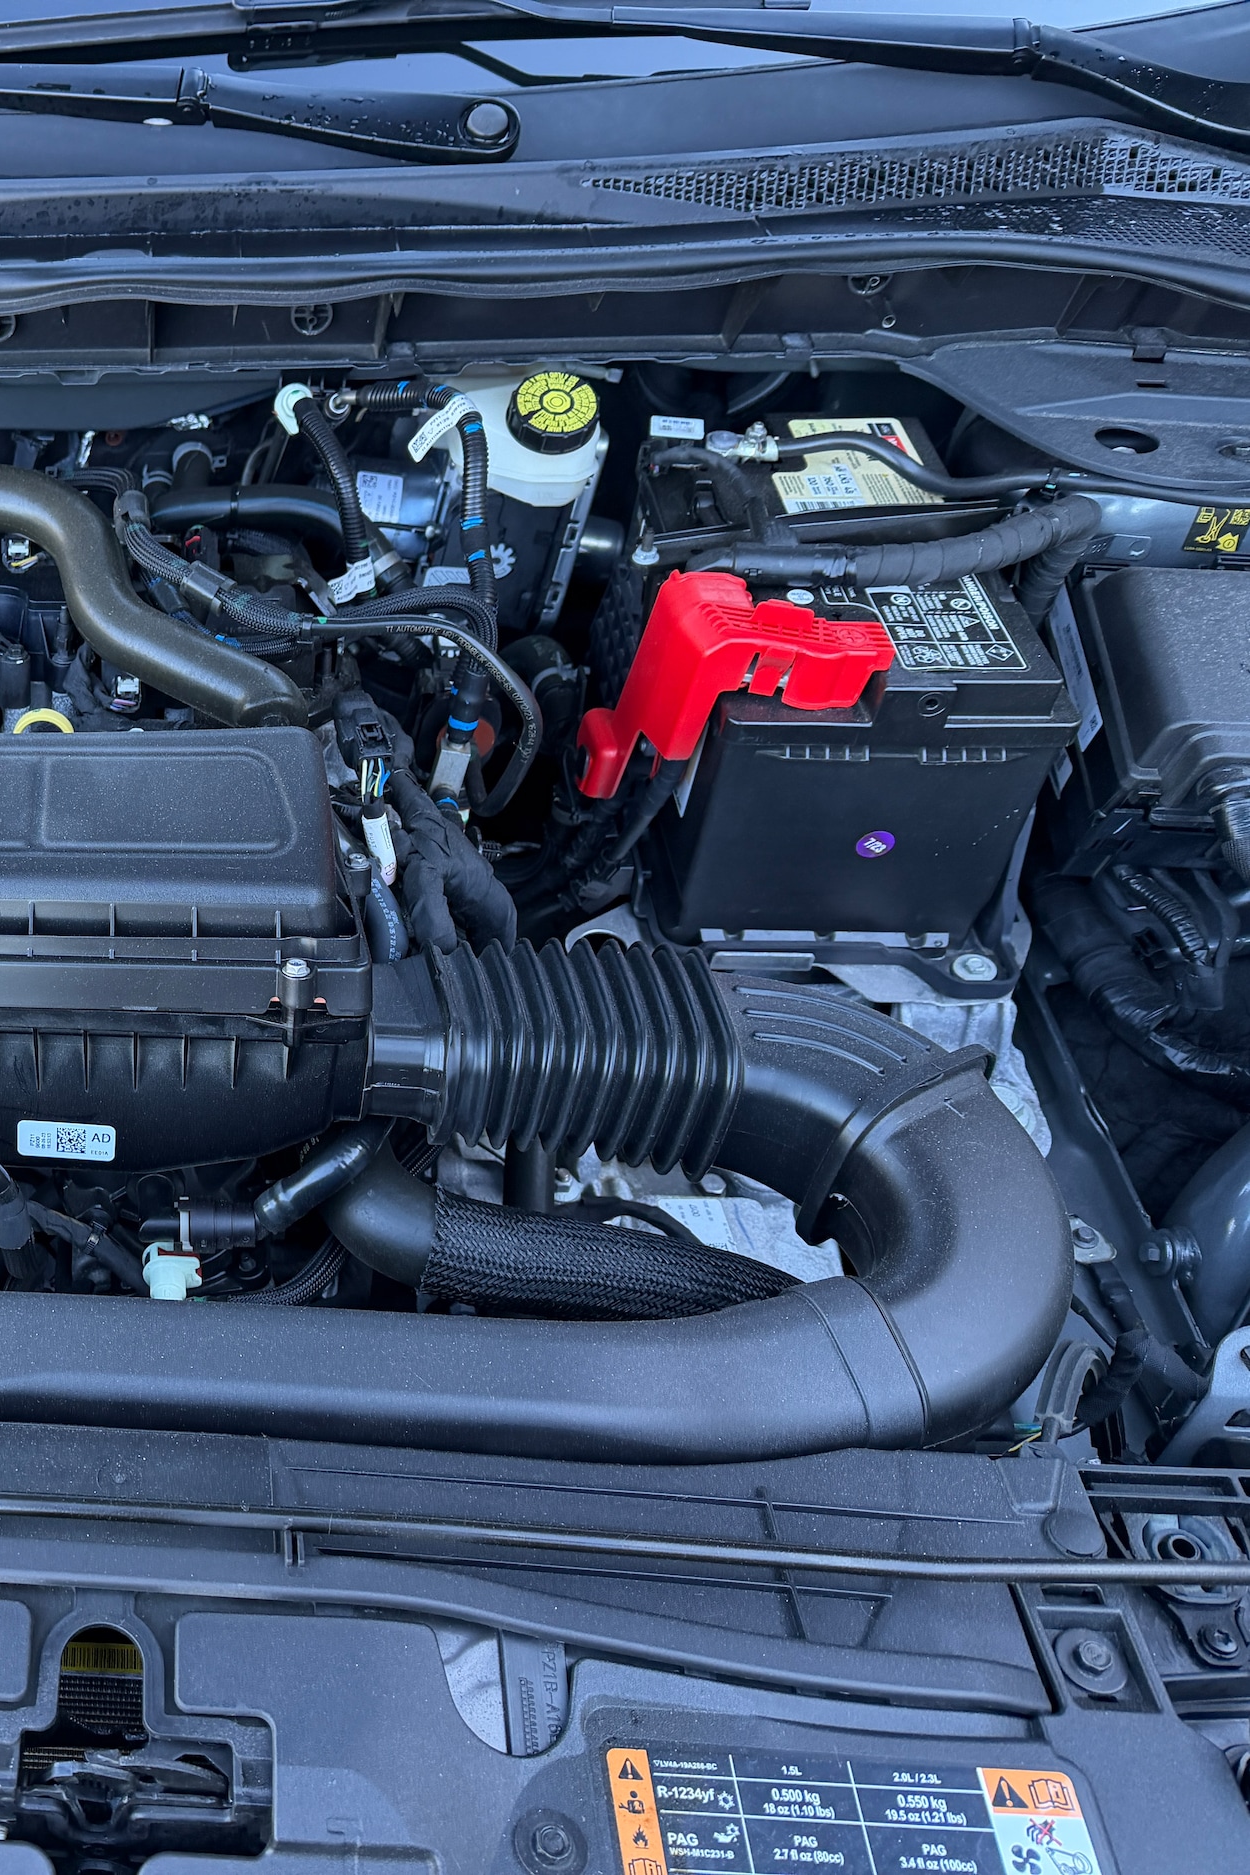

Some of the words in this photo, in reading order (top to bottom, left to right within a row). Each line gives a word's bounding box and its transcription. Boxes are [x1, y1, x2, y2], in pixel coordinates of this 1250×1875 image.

[961, 574, 1000, 630] ANGER/POISON
[396, 624, 441, 636] AUTOMOTIVE
[91, 1133, 111, 1143] AD
[781, 1764, 802, 1776] 1.5L
[892, 1772, 914, 1783] 2.0L
[920, 1773, 942, 1784] 2.3L
[656, 1785, 715, 1804] R-1234yf
[771, 1787, 802, 1802] 0.500
[804, 1790, 821, 1806] kg
[896, 1794, 930, 1809] 0.550
[931, 1797, 947, 1812] kg
[763, 1803, 777, 1815] 18
[777, 1806, 790, 1816] oz
[790, 1804, 814, 1817] (1.10
[815, 1806, 835, 1820] lbs)
[884, 1808, 906, 1822] 19.5
[907, 1811, 921, 1822] oz
[921, 1810, 945, 1825] (1.21
[947, 1811, 967, 1826] lbs)
[667, 1831, 699, 1847] PAG
[793, 1835, 818, 1848] PAG
[773, 1847, 789, 1860] 2.7
[789, 1848, 799, 1861] fl
[799, 1851, 813, 1862] oz
[813, 1850, 845, 1865] (80cc)
[922, 1843, 947, 1857] PAG
[899, 1856, 916, 1870] 3.4
[916, 1857, 926, 1870] fl
[926, 1860, 939, 1871] oz
[940, 1858, 978, 1874] (100cc)
